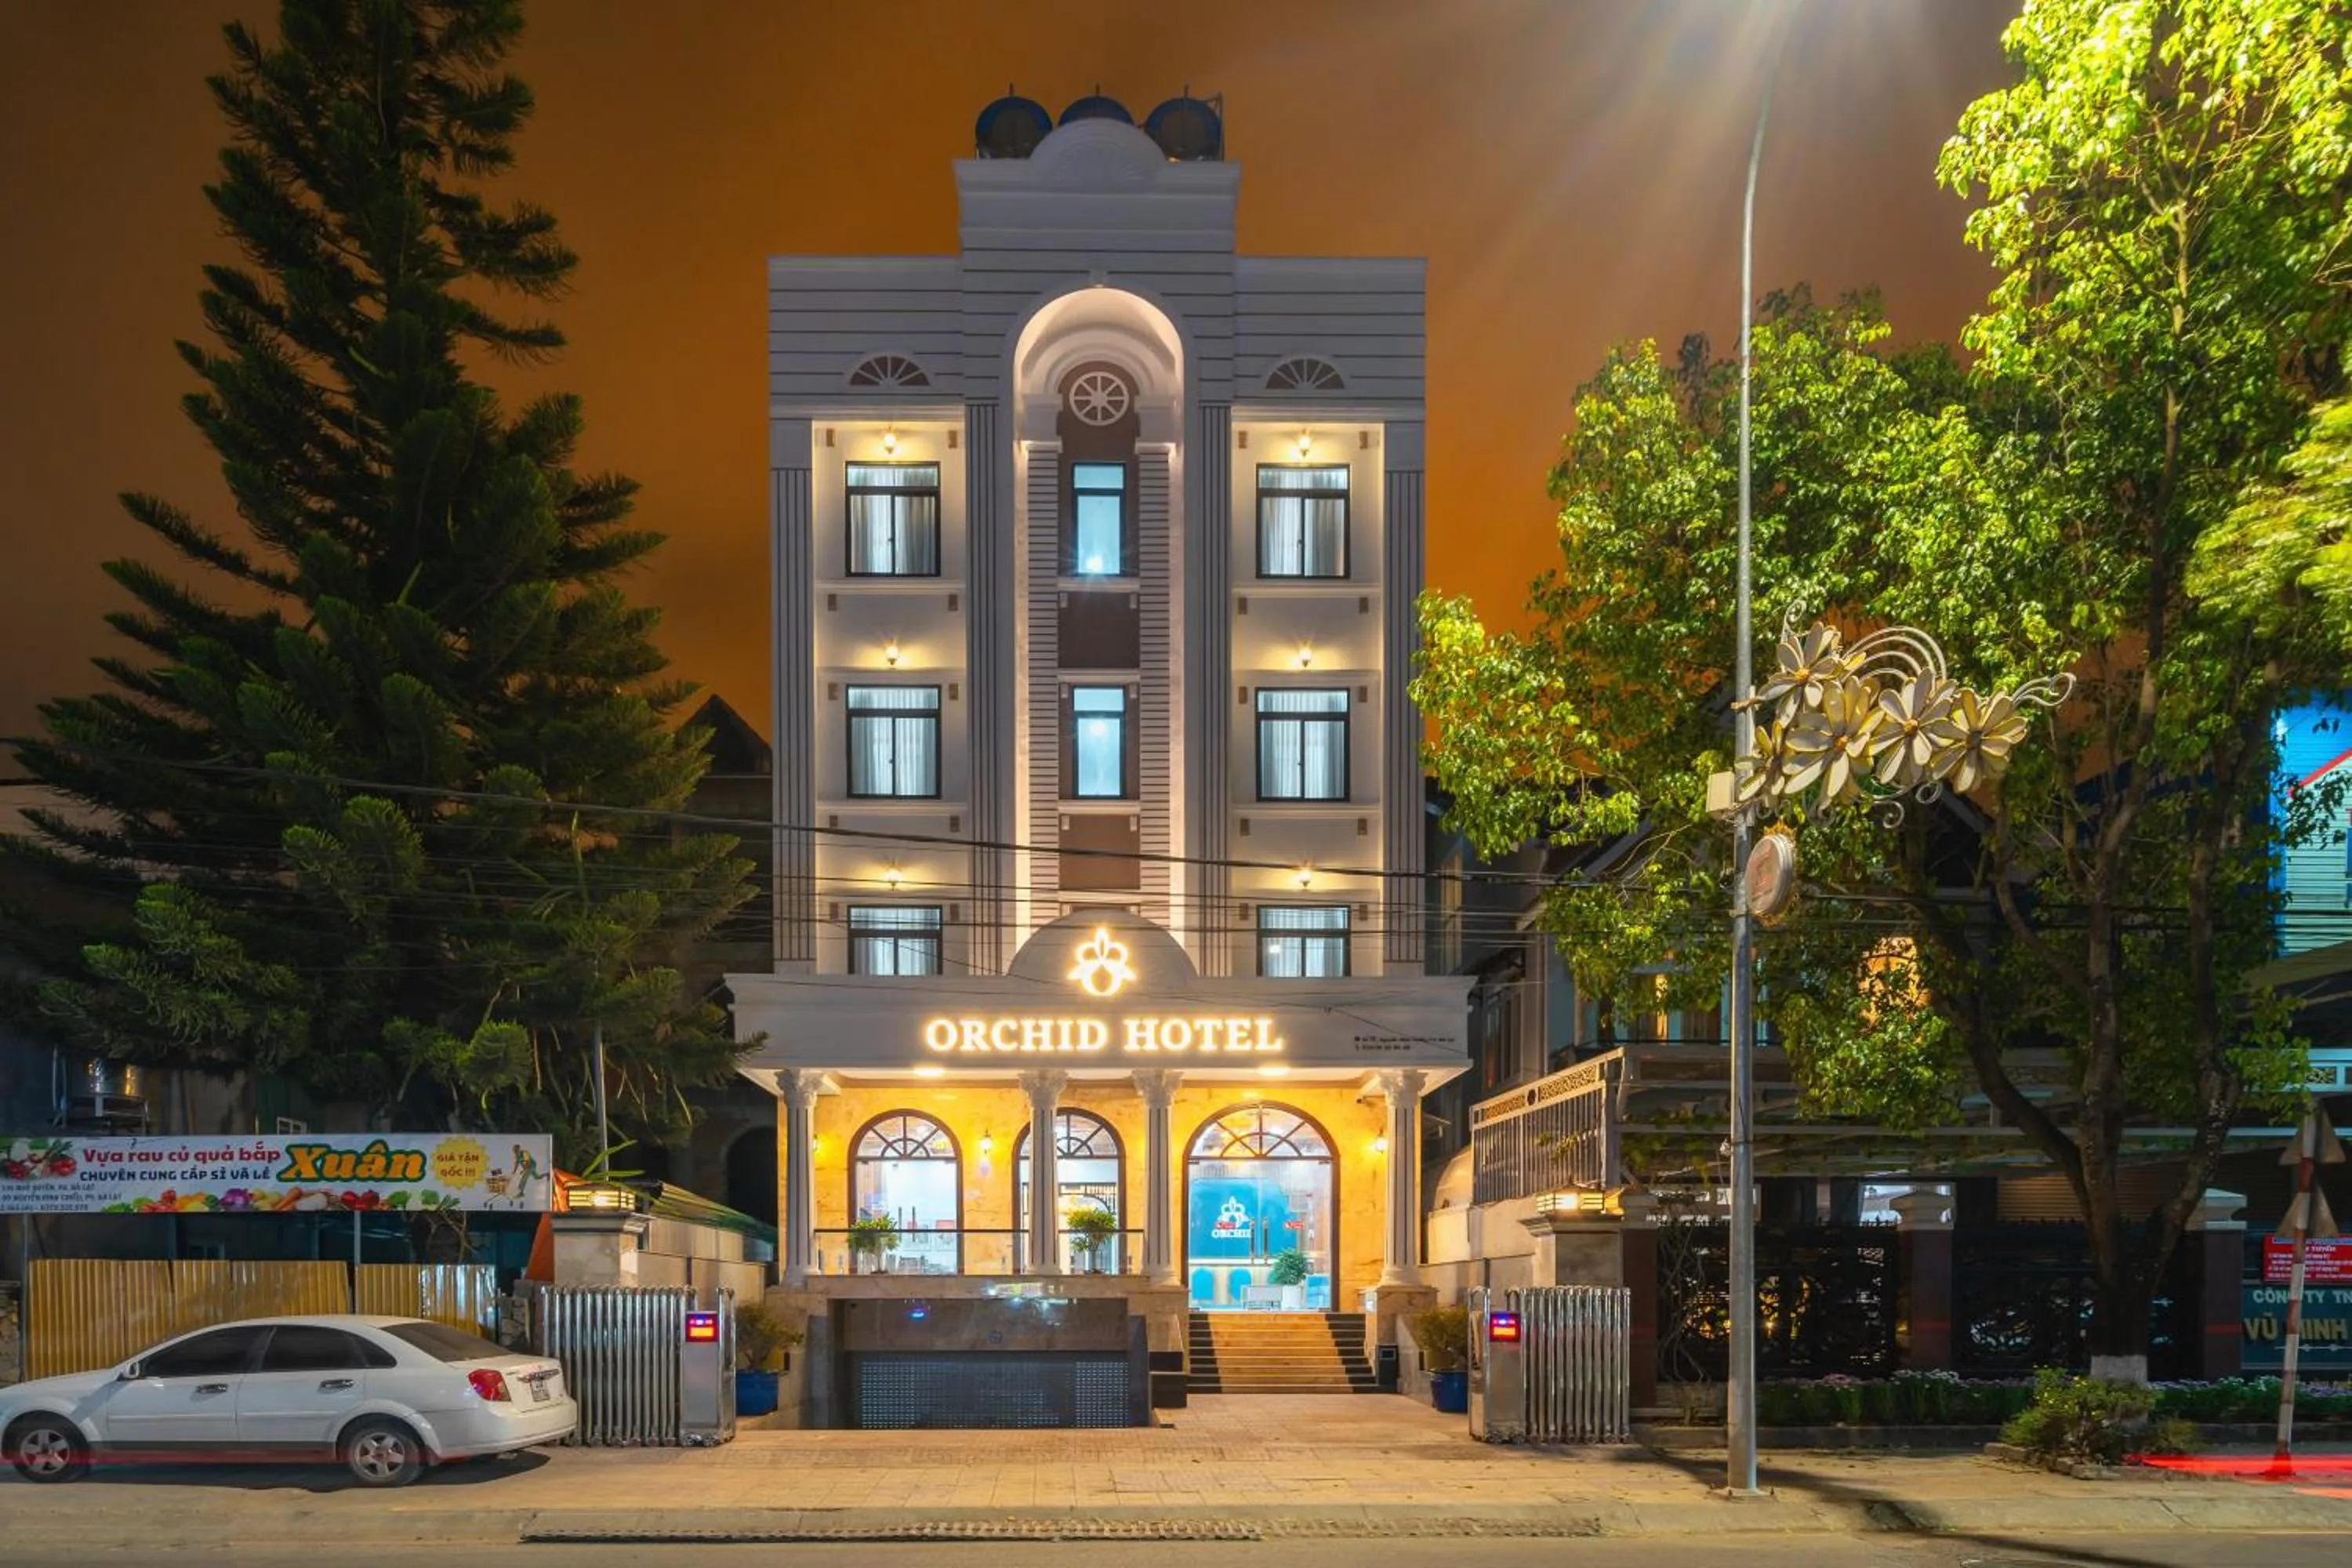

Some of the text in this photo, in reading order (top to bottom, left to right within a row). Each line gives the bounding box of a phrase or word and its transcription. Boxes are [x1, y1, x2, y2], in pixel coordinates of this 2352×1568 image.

[926, 1018, 1284, 1051] ORCHID HOTEL
[83, 1141, 281, 1167] Vựa rau củ quả bắp
[279, 1140, 425, 1181] Xuân
[437, 1151, 479, 1163] GIÁ TẬN
[80, 1167, 136, 1181] CHUYÊN
[140, 1171, 176, 1180] CUNG
[181, 1166, 208, 1180] CẤP
[441, 1165, 463, 1177] GỐC
[2252, 1287, 2290, 1303] CÔN
[2305, 1290, 2325, 1303] TY
[2243, 1312, 2278, 1341] VŨ
